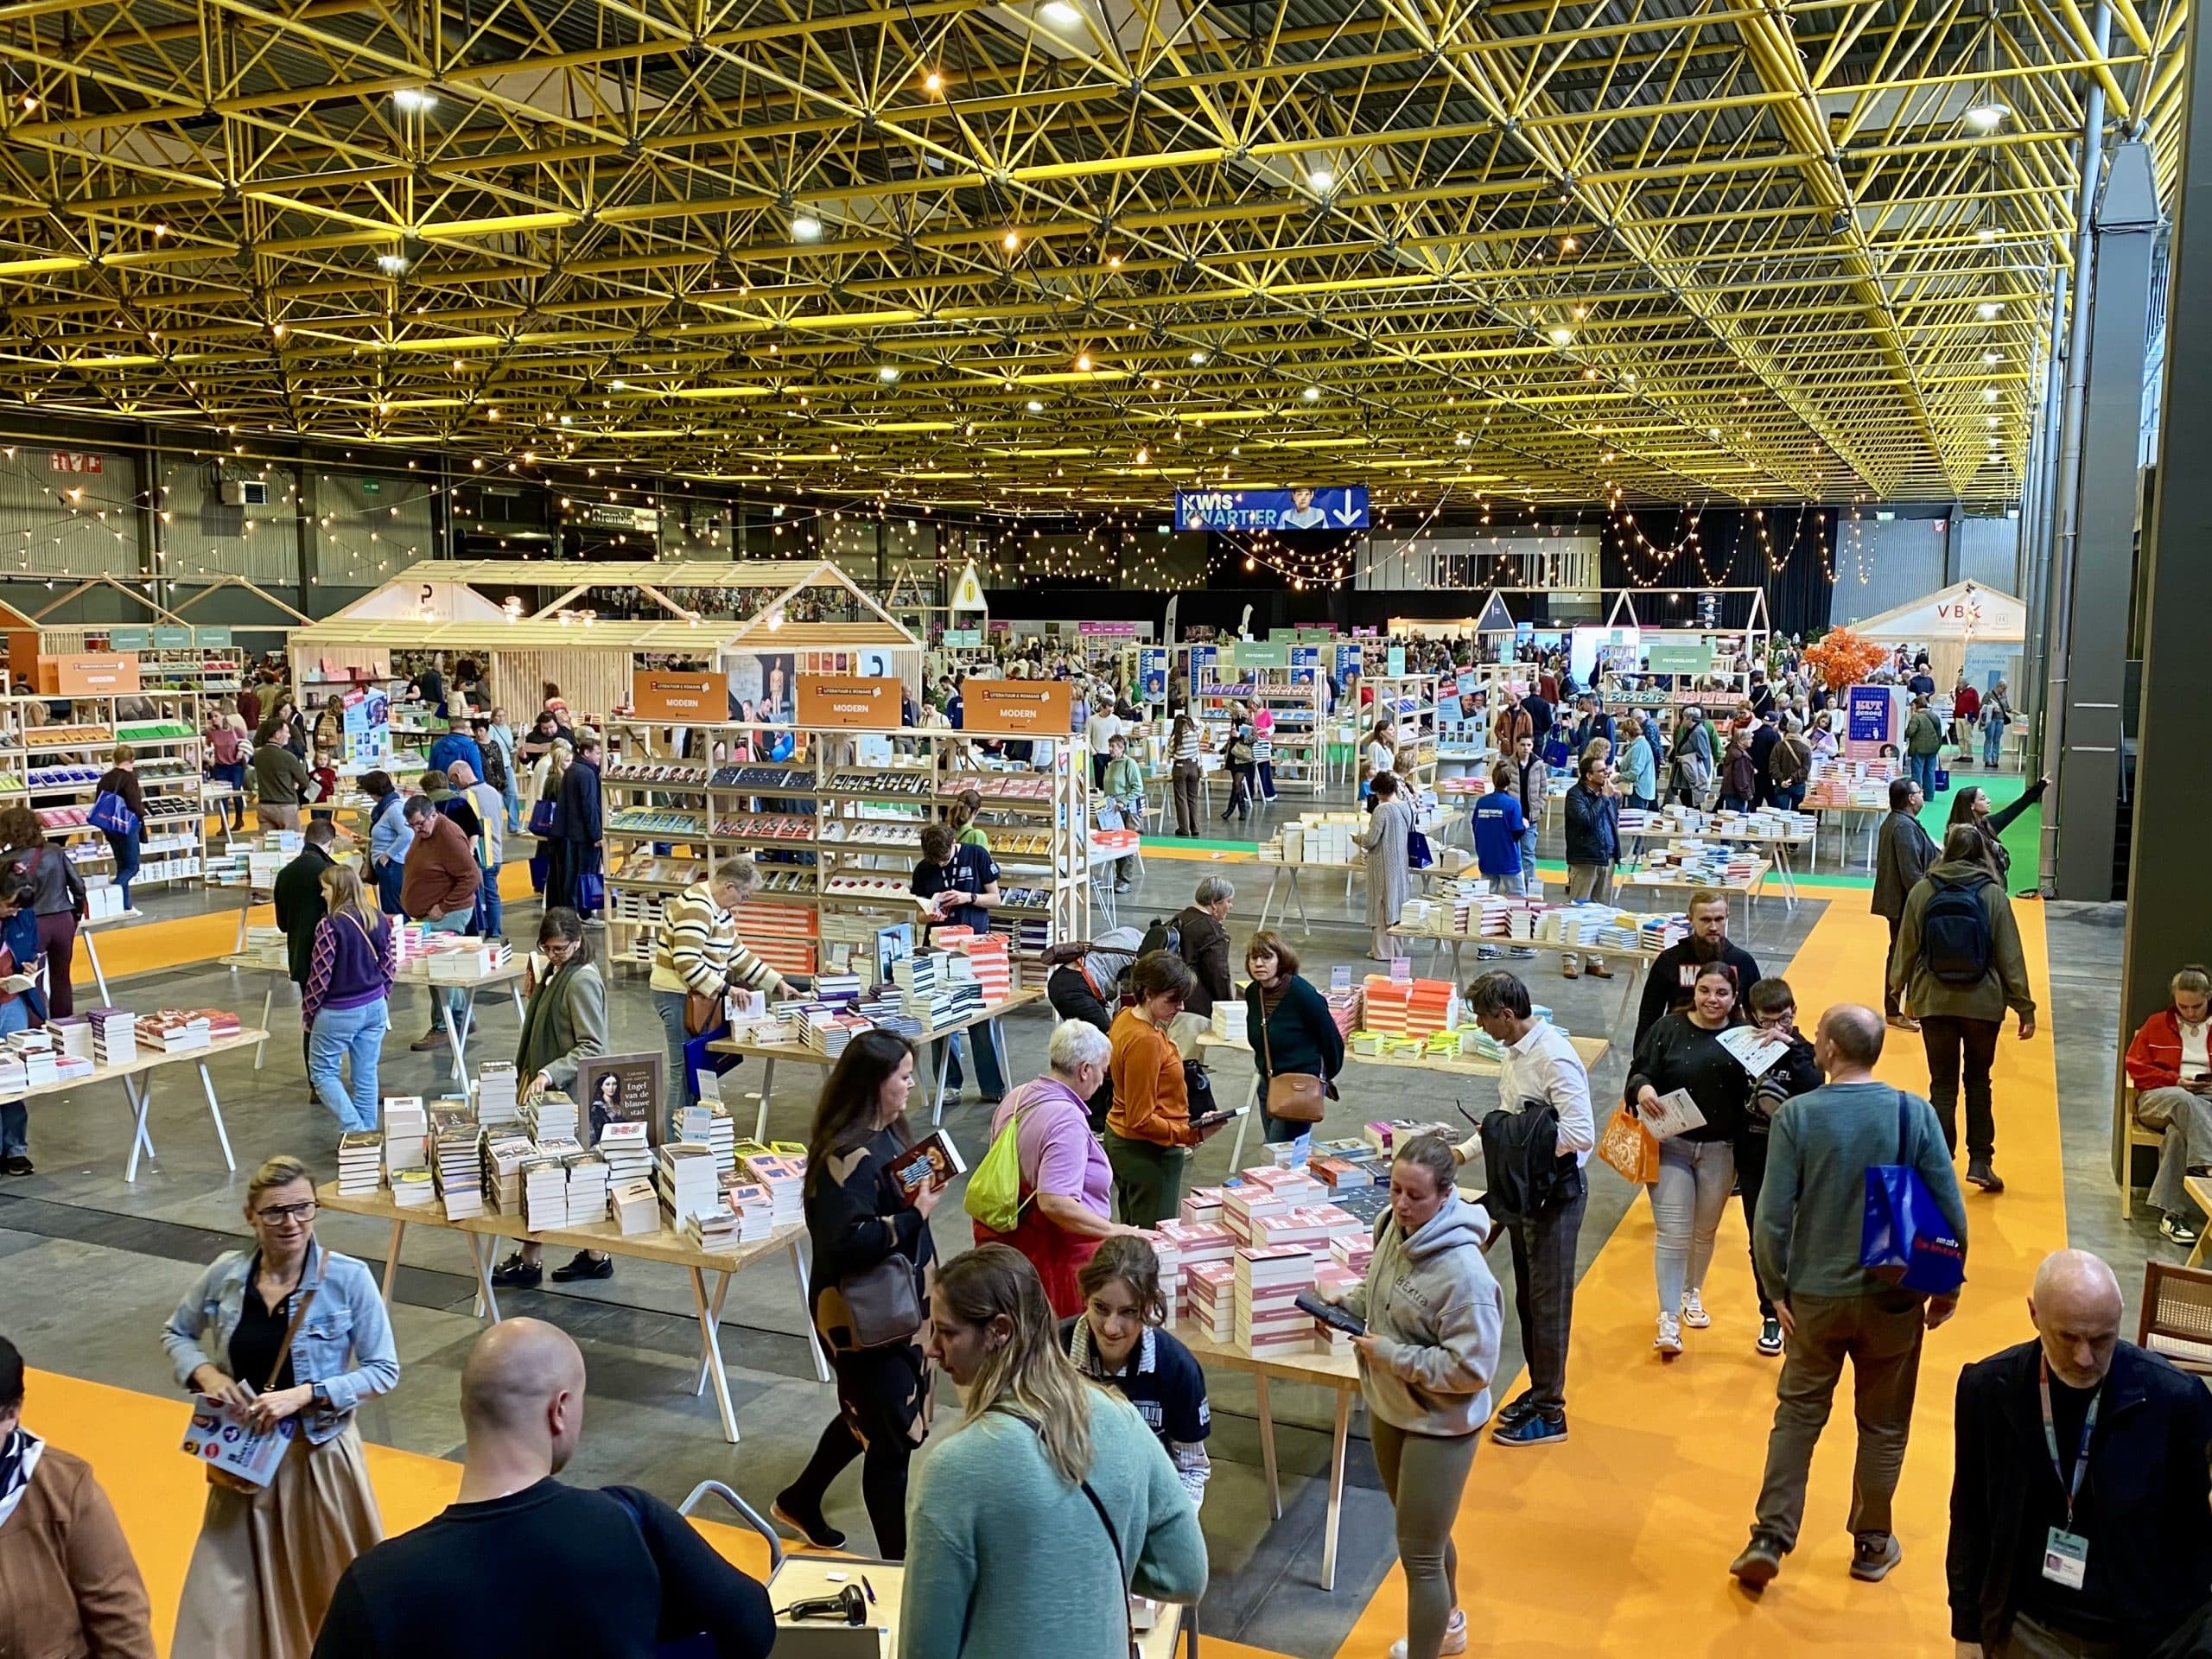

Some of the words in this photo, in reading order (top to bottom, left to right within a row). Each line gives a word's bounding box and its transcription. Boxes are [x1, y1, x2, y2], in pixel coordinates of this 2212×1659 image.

[1182, 493, 1233, 510] KWIS
[1182, 509, 1277, 525] KWARTIER
[666, 698, 698, 707] MODERN
[833, 703, 868, 713] MODERN
[1000, 709, 1037, 718] MODERN
[627, 1081, 646, 1092] Engel
